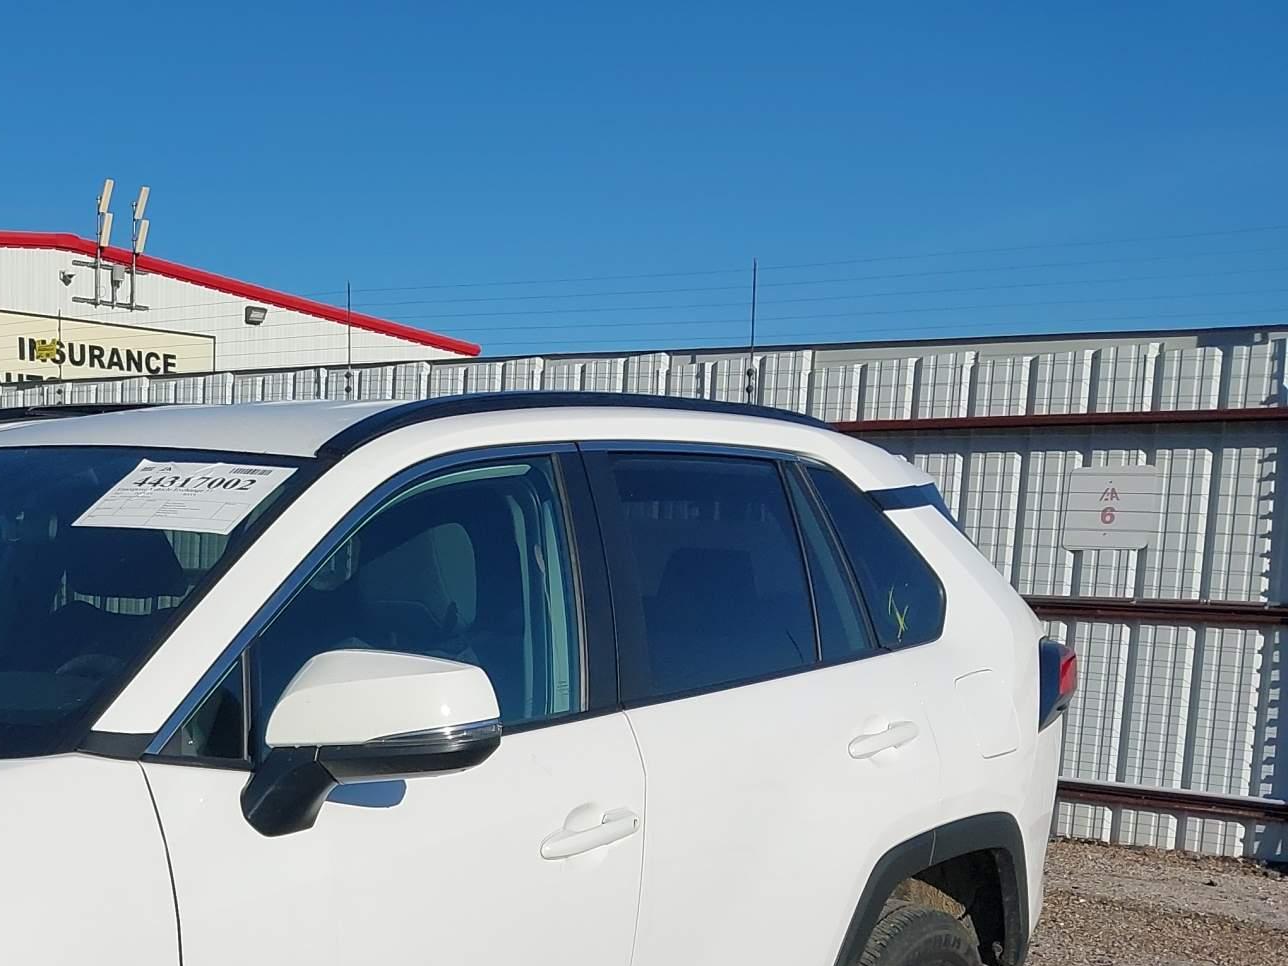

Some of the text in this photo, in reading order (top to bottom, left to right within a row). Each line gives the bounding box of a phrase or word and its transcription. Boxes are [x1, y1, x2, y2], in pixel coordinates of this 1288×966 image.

[18, 336, 177, 374] INSURANCE
[133, 475, 257, 491] 44317002
[1100, 506, 1116, 524] 6
